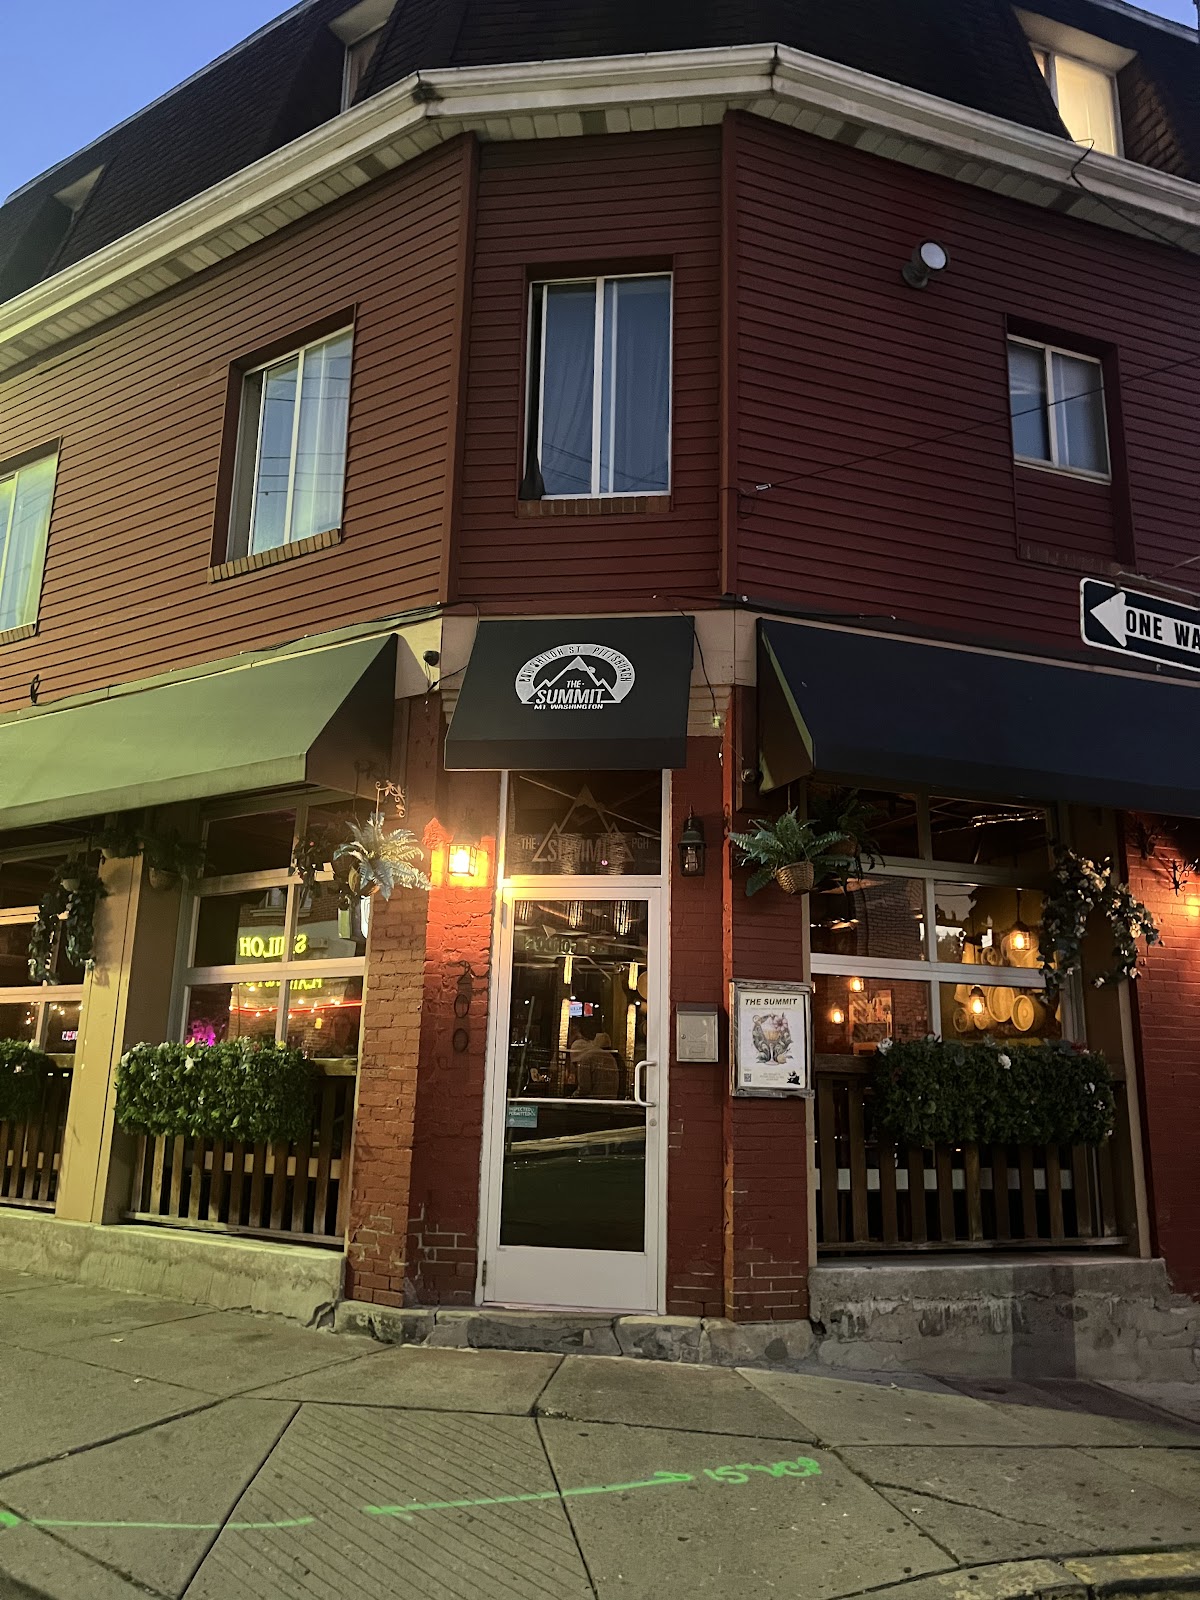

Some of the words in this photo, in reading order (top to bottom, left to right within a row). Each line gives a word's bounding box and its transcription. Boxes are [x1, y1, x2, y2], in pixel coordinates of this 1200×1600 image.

[1126, 609, 1163, 641] ONE
[568, 646, 581, 654] ST
[592, 647, 632, 682] PITTSBURGH
[566, 680, 581, 688] THE
[535, 688, 605, 704] SUMMIT
[521, 838, 536, 850] THE
[631, 837, 649, 850] PGH
[745, 998, 762, 1006] THE
[763, 998, 798, 1006] SUMMIT
